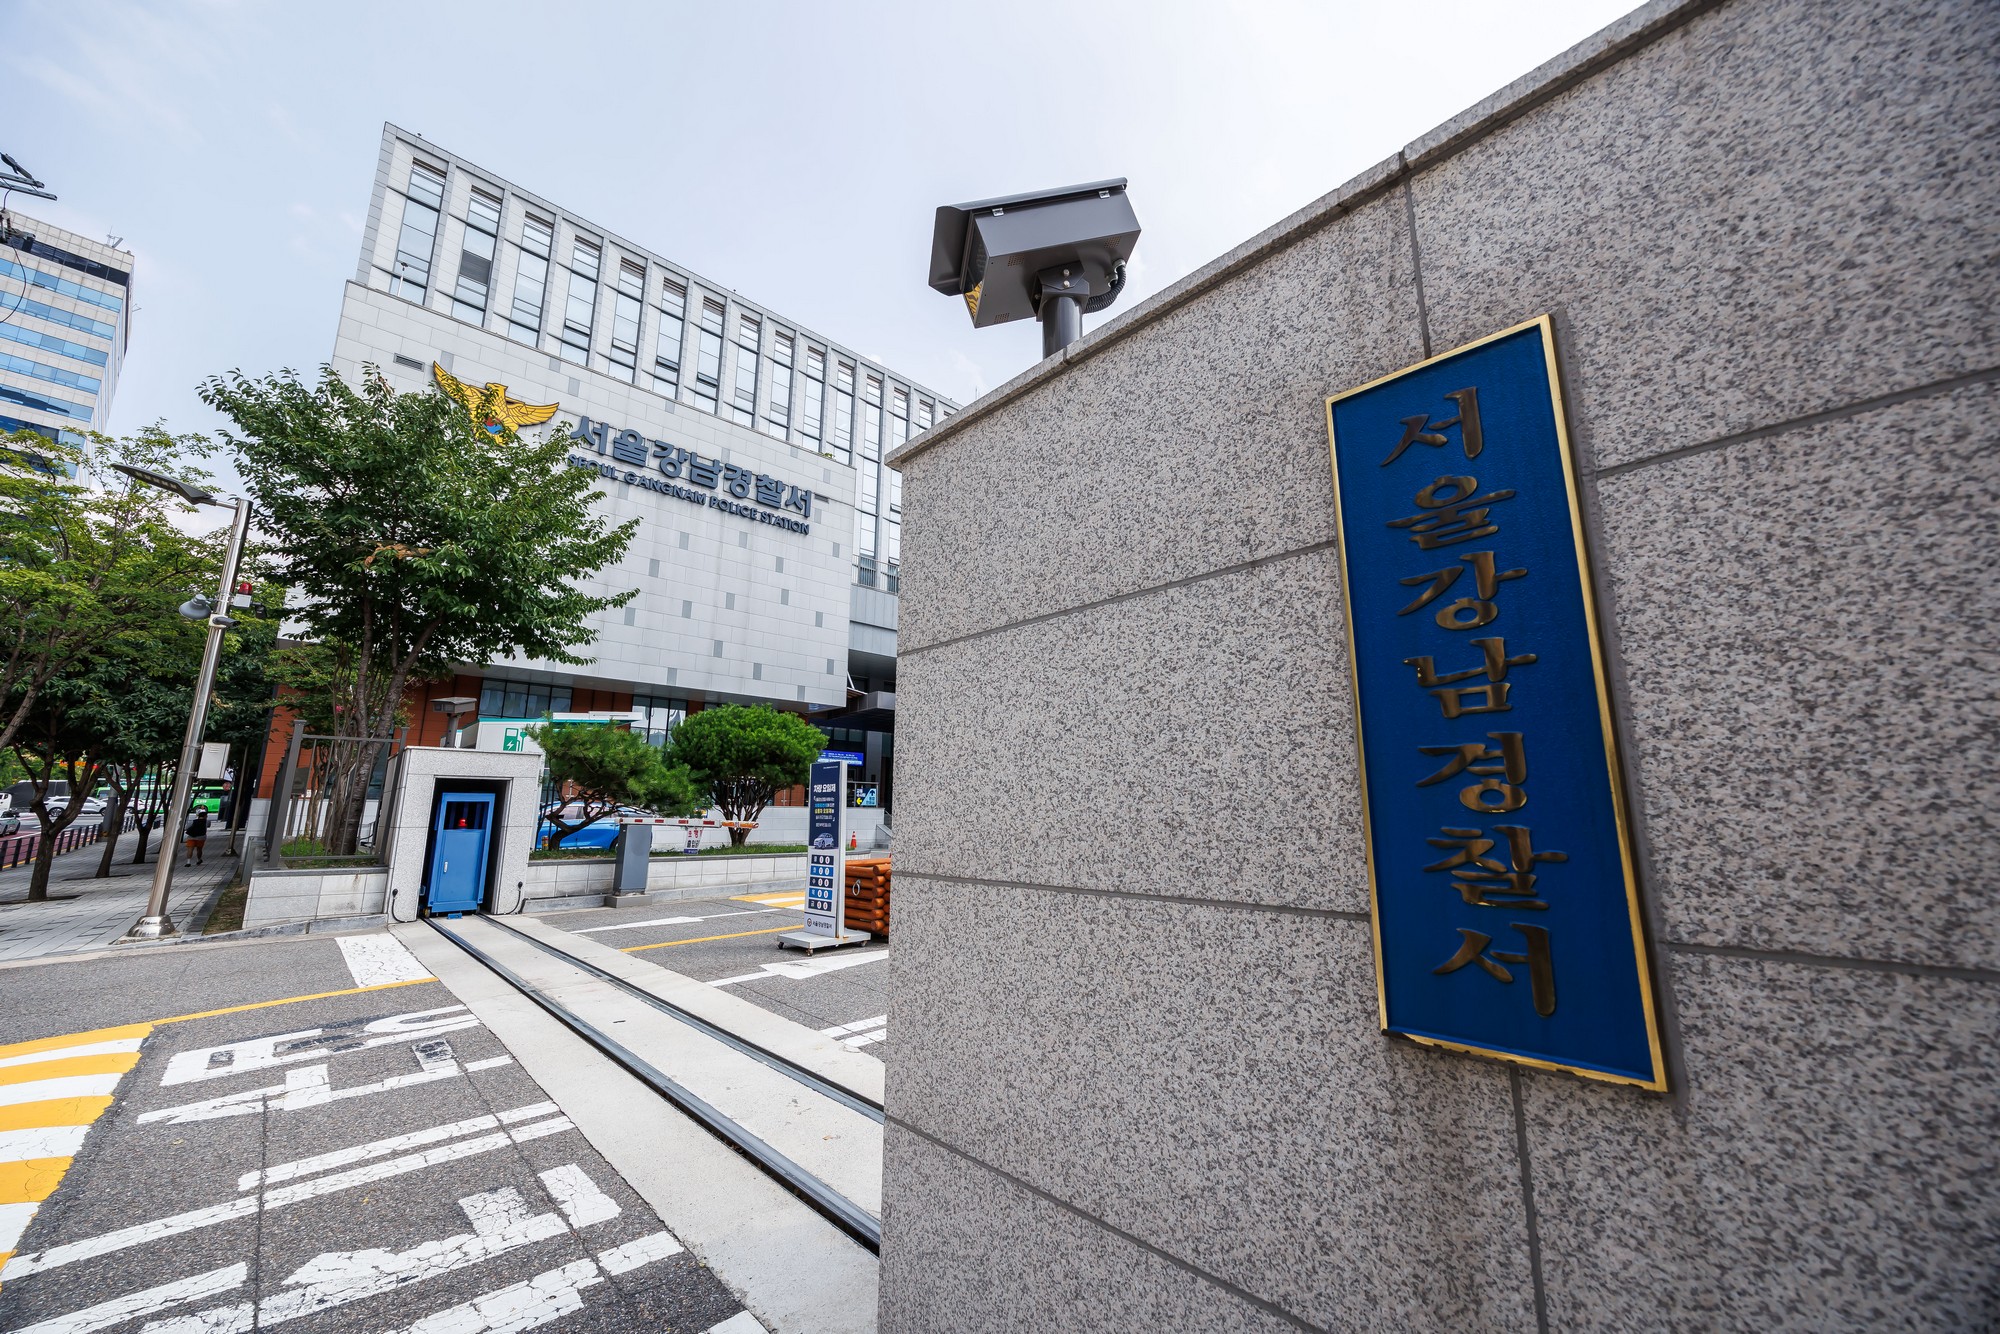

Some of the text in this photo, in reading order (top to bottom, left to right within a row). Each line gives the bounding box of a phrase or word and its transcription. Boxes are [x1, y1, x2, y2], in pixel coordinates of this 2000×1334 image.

[567, 453, 810, 536] SEOUL GANGNAM POLICE STATION
[570, 415, 812, 518] 서울강남경찰서
[1380, 385, 1569, 1018] 서울강남경찰서
